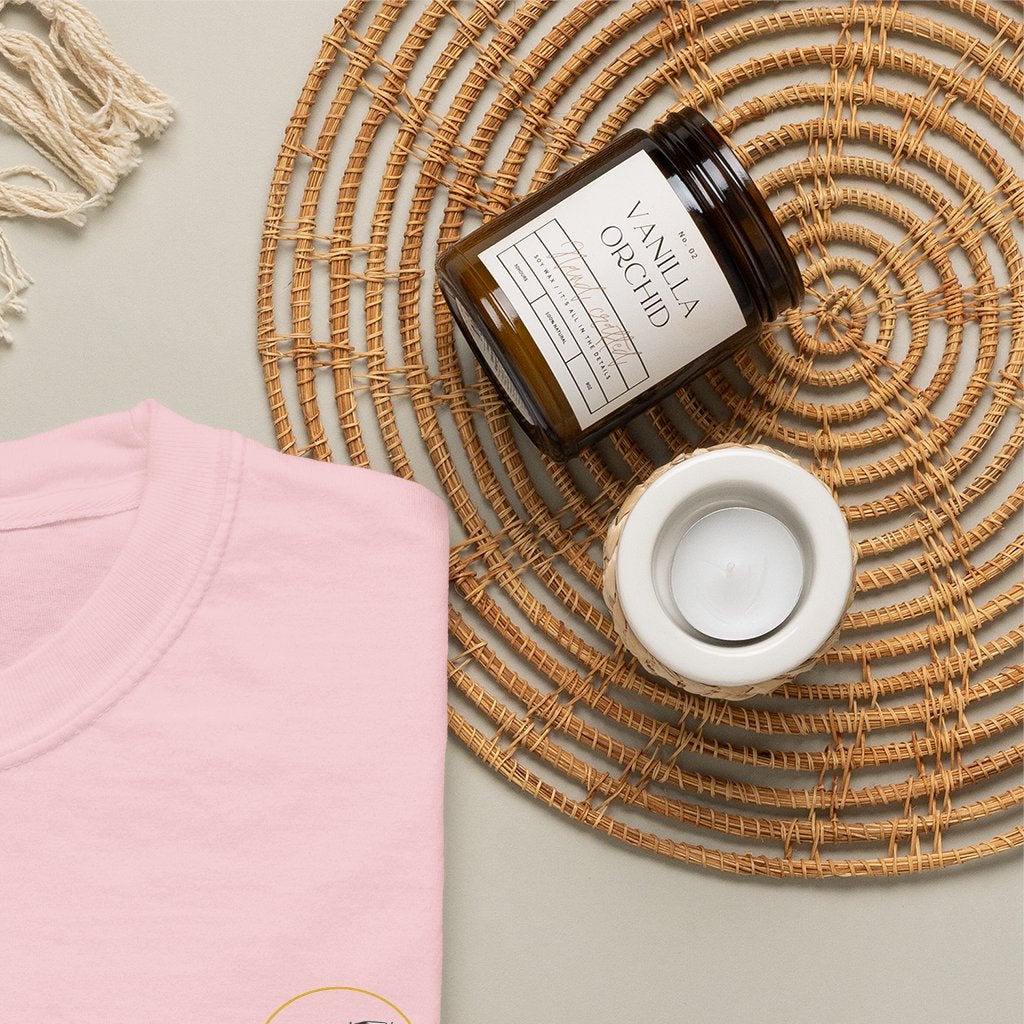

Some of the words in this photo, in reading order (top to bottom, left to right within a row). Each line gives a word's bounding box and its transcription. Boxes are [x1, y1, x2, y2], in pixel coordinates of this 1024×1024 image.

[600, 225, 670, 328] ORCHID
[626, 200, 700, 319] VANILLA
[688, 248, 698, 260] 02
[533, 254, 545, 267] SOY
[543, 268, 555, 284] WAX
[558, 291, 570, 306] IT'S
[568, 308, 579, 323] ALL
[578, 324, 586, 334] IN
[585, 335, 596, 350] THE
[593, 351, 611, 380] DETAILS
[553, 323, 567, 345] NATURAL
